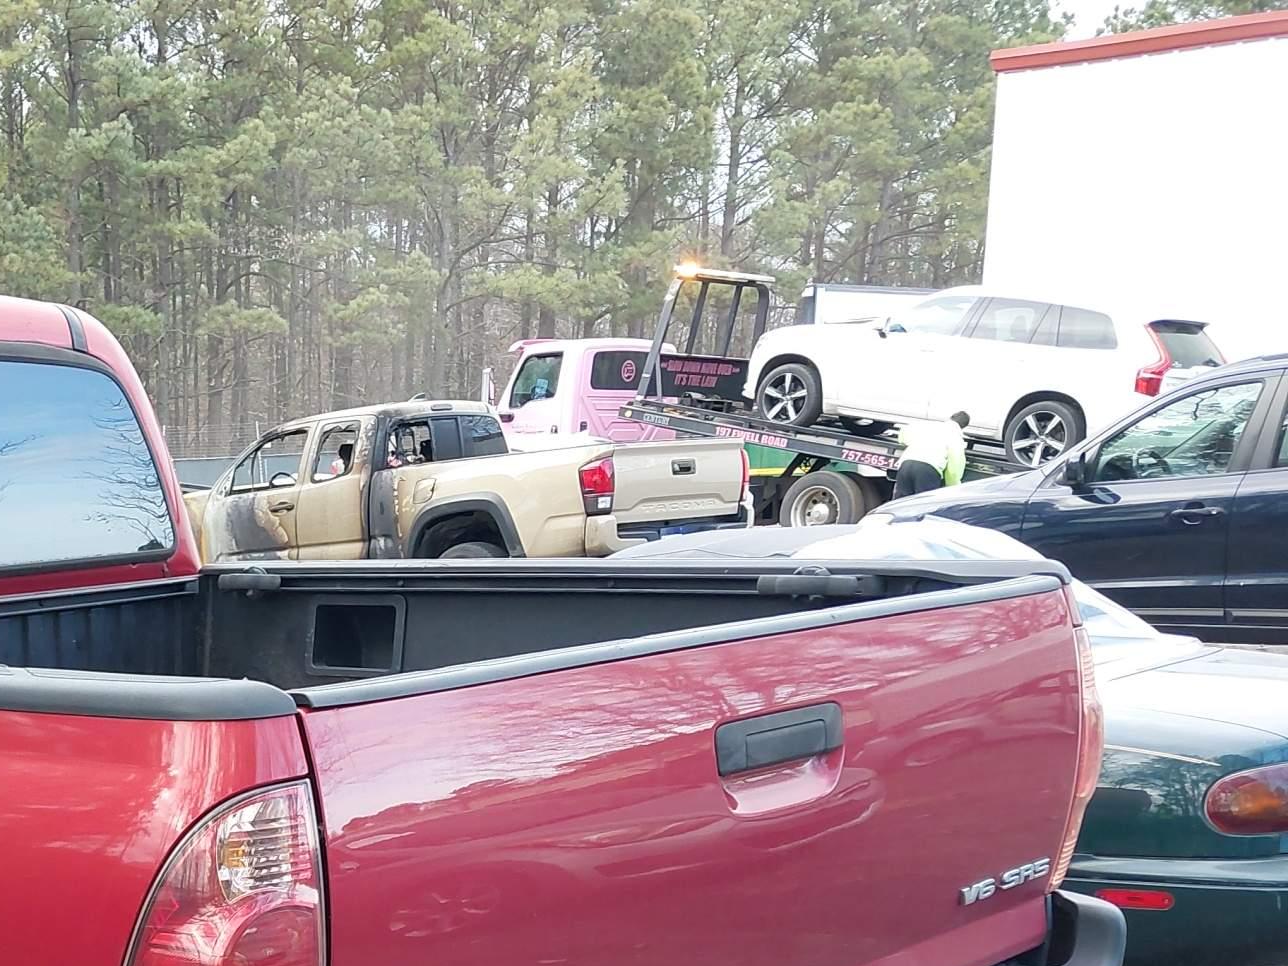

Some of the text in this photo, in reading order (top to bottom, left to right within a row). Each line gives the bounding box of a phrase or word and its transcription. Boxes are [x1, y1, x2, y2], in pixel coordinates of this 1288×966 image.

[715, 426, 731, 437] 197
[761, 434, 788, 448] ROAD
[640, 498, 716, 513] TACOMA
[960, 857, 1050, 906] V6 SR5
